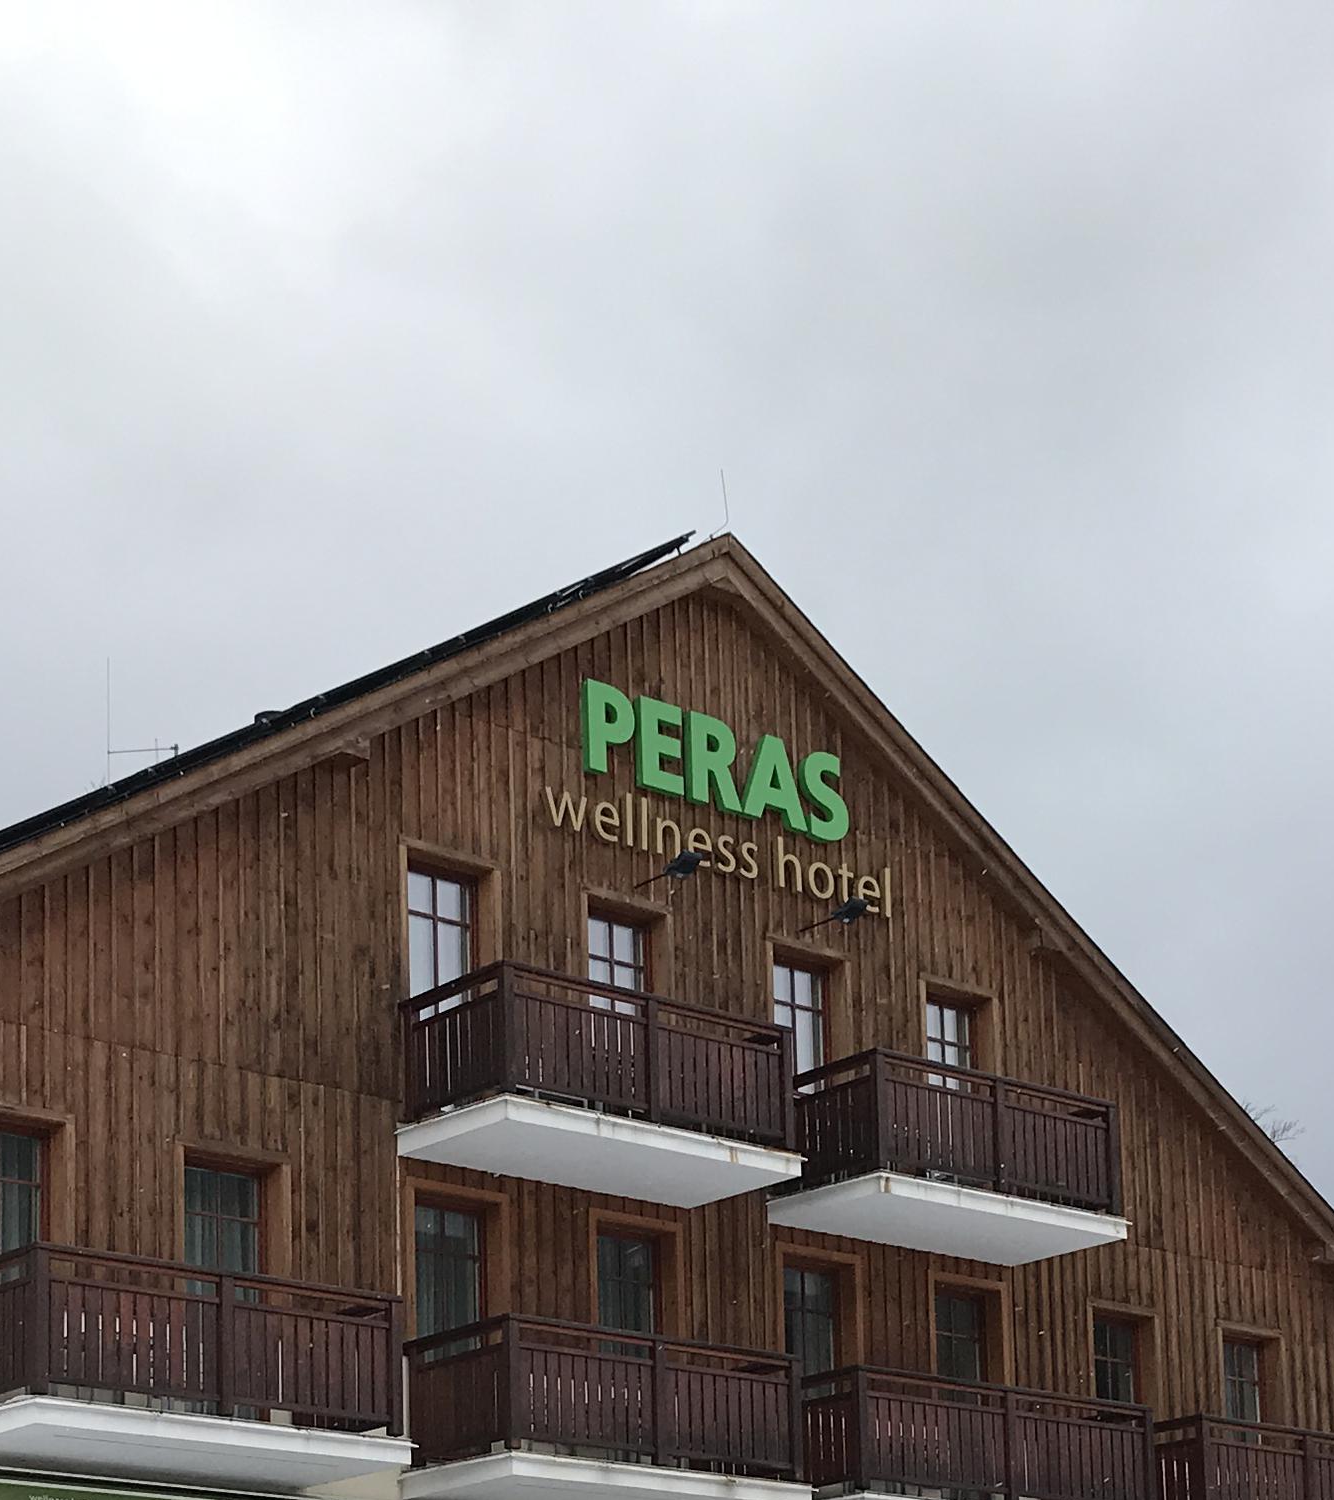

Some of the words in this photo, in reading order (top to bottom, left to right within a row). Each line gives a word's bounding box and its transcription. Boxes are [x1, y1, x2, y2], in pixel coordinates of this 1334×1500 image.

[582, 678, 849, 843] PERAS
[545, 786, 759, 879] wellness
[777, 836, 892, 918] hotel
